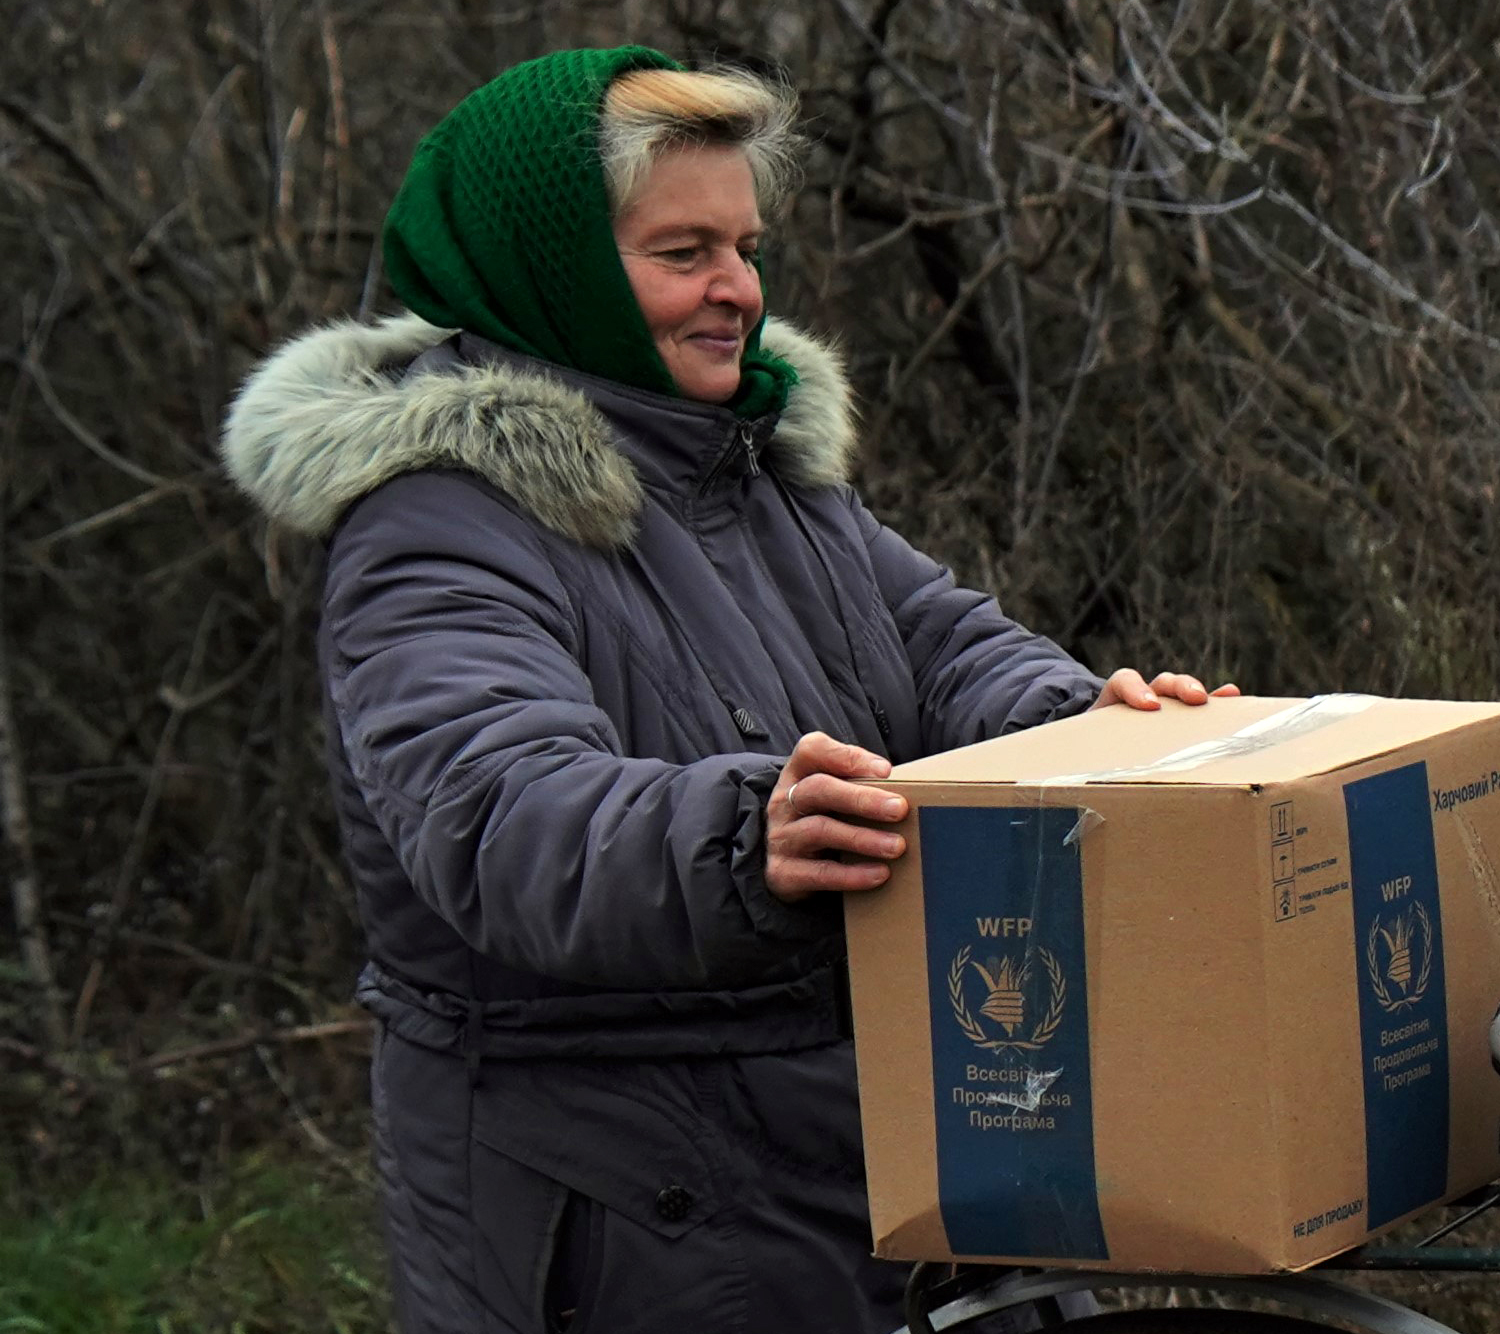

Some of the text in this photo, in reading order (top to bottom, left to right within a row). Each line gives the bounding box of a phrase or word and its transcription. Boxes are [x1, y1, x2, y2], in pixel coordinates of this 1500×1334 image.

[1433, 772, 1490, 812] Харчовий
[1381, 875, 1412, 902] WFP
[976, 917, 1034, 938] WFP
[1381, 1018, 1431, 1047] Всесвітня
[1373, 1037, 1439, 1073] Продовольча
[1383, 1063, 1432, 1092] Програма
[969, 1110, 1056, 1131] Програма
